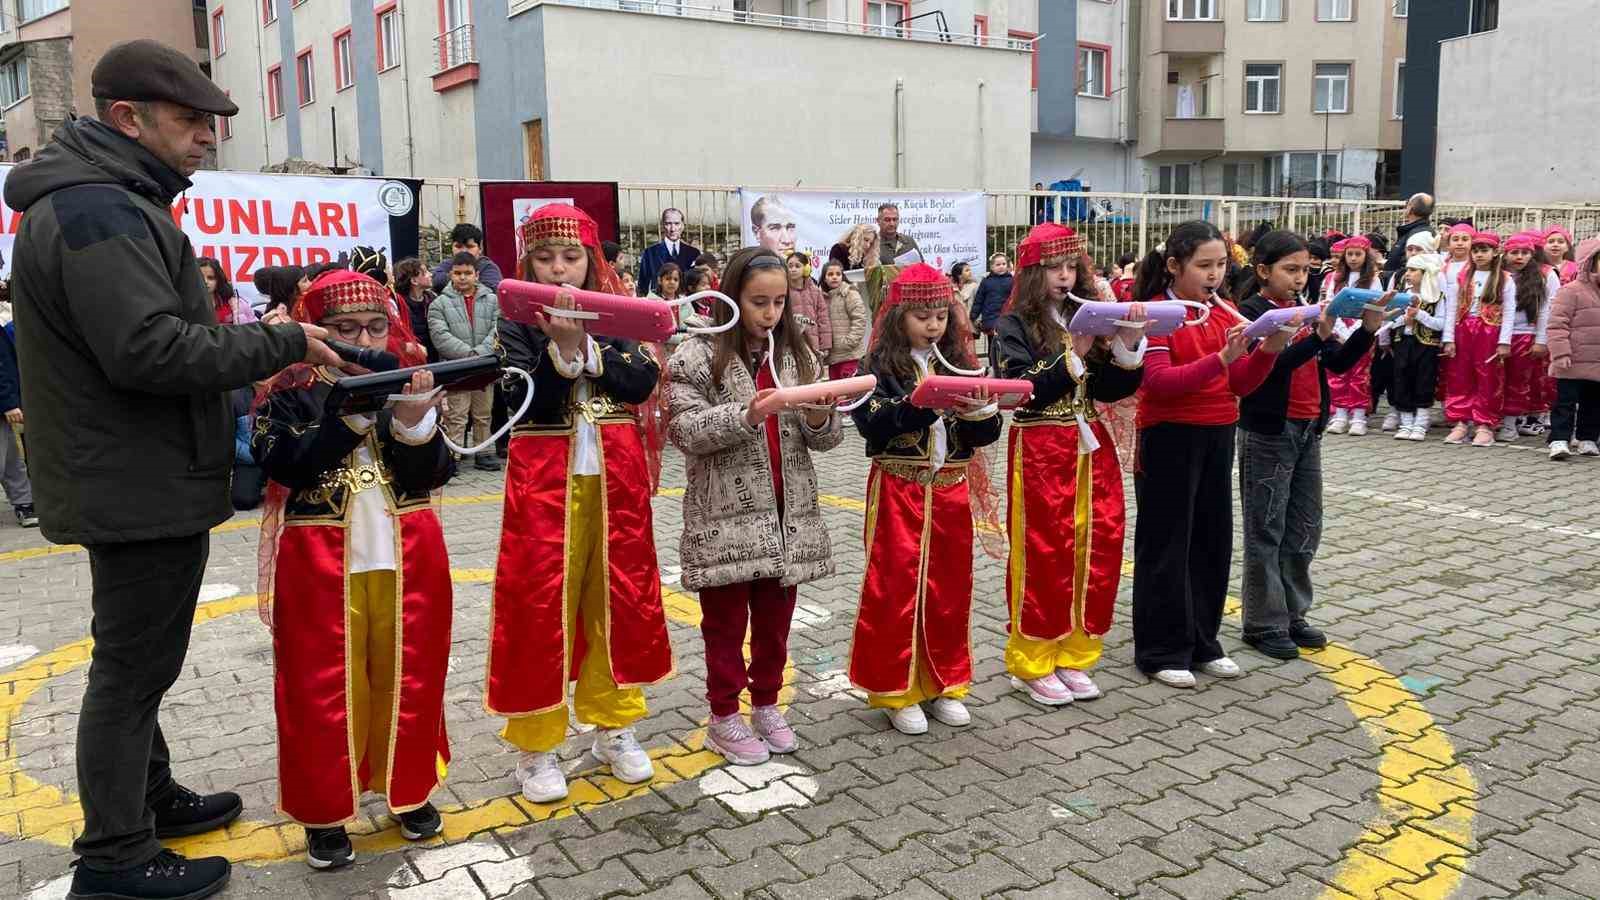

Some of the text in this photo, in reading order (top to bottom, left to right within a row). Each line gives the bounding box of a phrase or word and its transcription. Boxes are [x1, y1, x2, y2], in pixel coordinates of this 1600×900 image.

[171, 197, 359, 237] YUNLARI
[829, 214, 851, 225] Sizler
[924, 214, 937, 224] Bir
[735, 477, 755, 509] HELLO
[690, 529, 719, 549] HELLO
